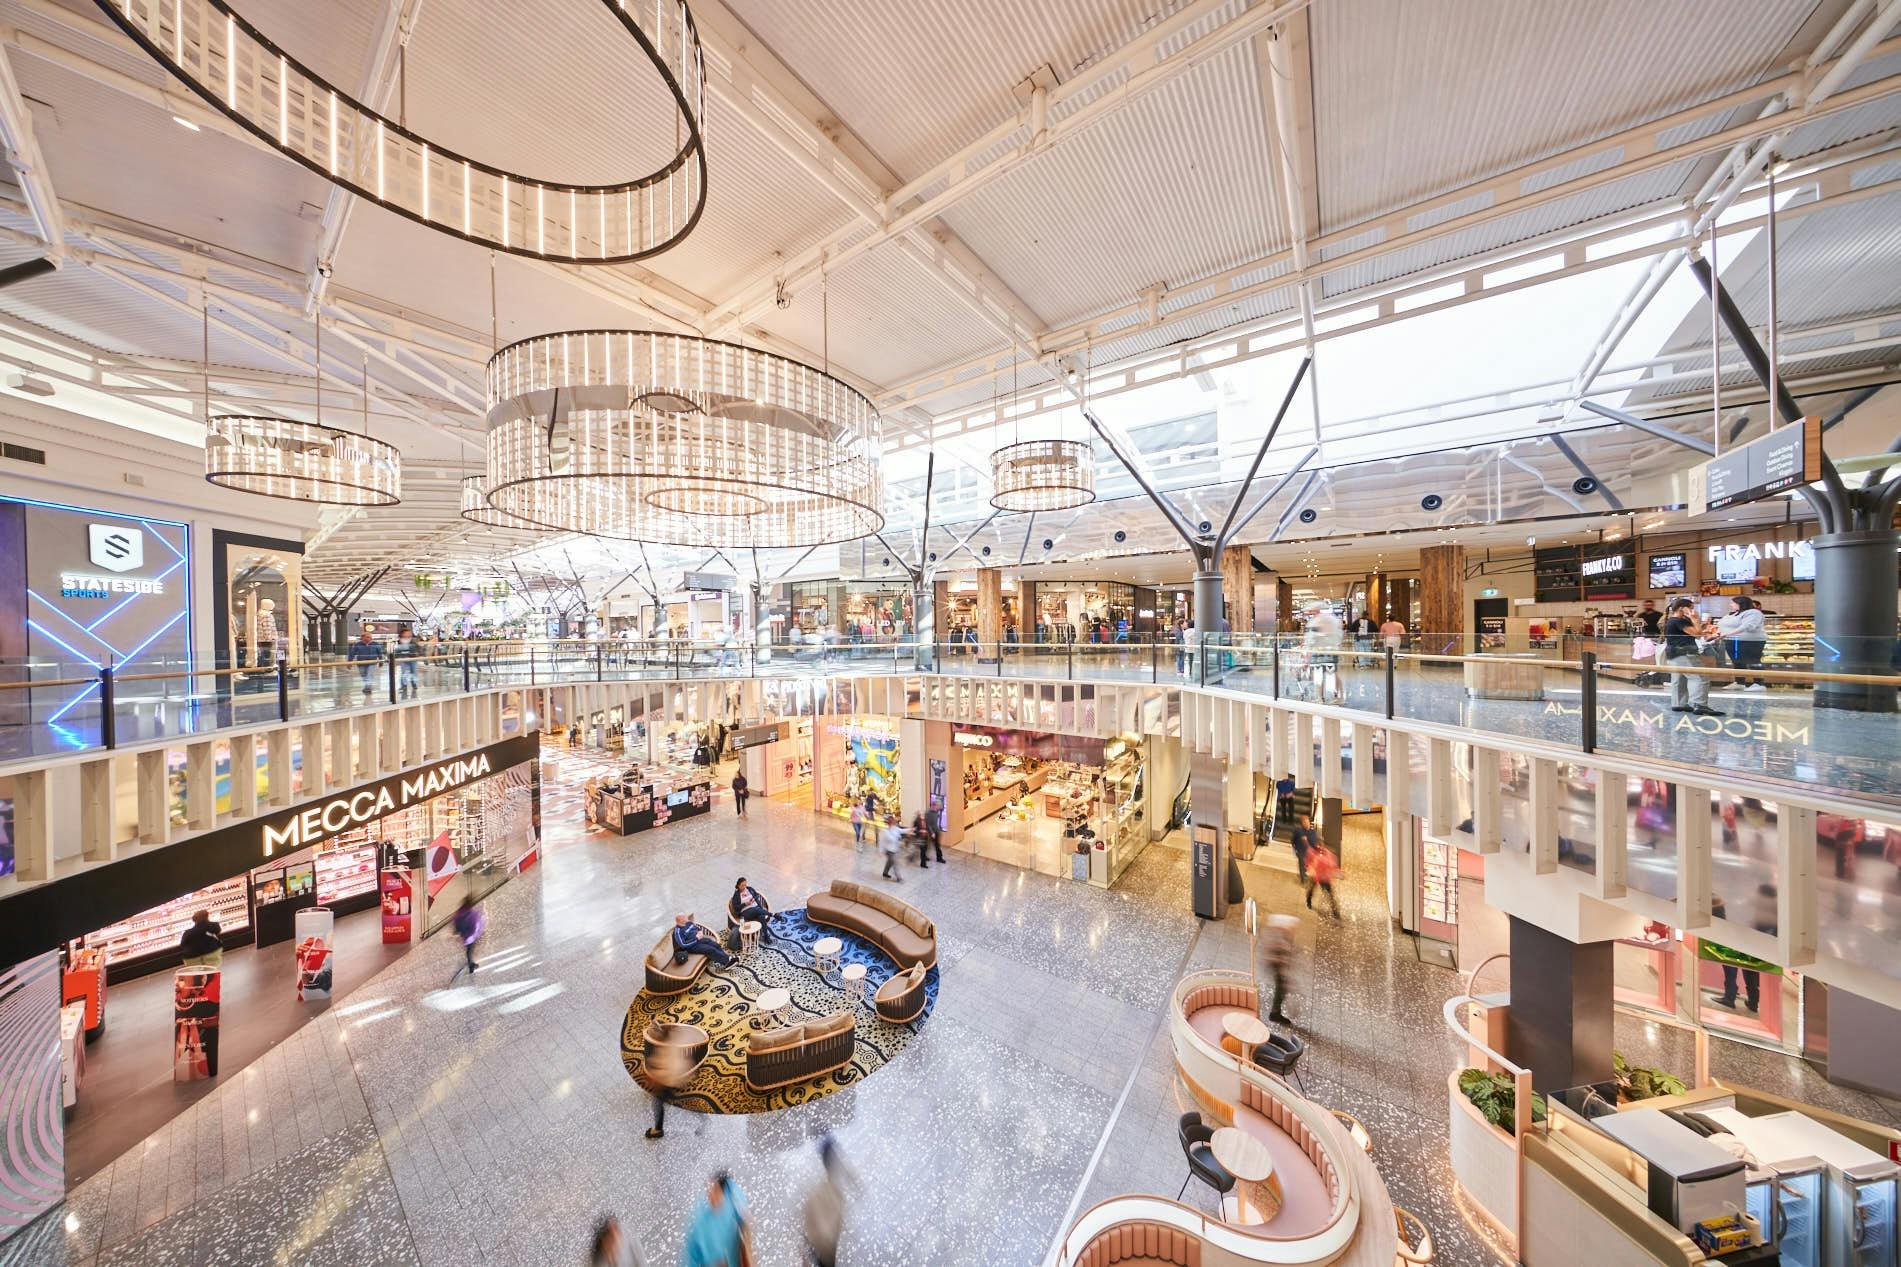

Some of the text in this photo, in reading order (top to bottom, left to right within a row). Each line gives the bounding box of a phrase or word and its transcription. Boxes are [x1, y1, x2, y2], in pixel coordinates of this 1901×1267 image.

[1708, 540, 1814, 562] FRANK
[1582, 555, 1622, 577] FRANKY&CO
[62, 575, 164, 594] STATESIDE
[62, 588, 109, 599] SPORTS
[262, 753, 491, 857] MECCA MAXIMA
